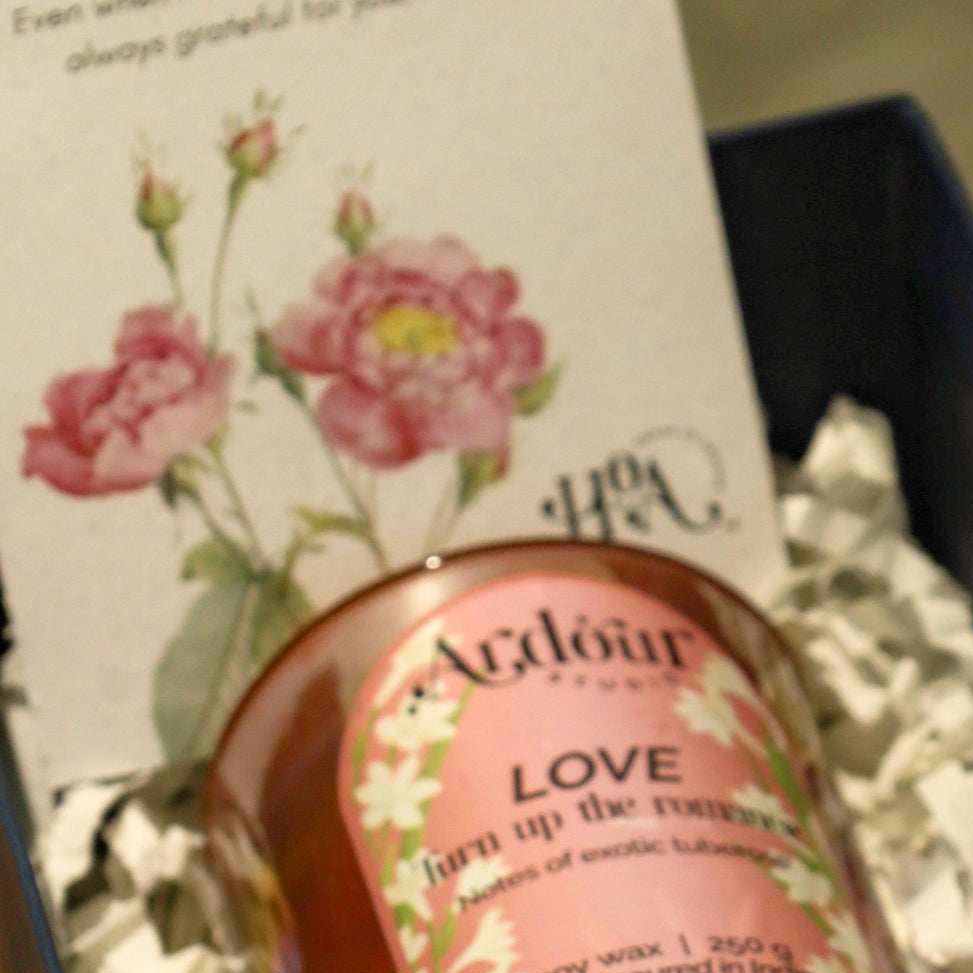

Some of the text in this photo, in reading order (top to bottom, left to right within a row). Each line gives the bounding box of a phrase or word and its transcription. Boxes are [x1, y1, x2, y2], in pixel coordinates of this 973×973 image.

[12, 5, 84, 37] Even
[66, 40, 168, 74] always
[175, 0, 292, 58] grateful
[512, 745, 684, 804] LOVE
[513, 810, 564, 842] up
[578, 792, 636, 822] the
[457, 865, 540, 911] Notes
[546, 850, 572, 874] of
[581, 838, 664, 863] exotic
[597, 939, 662, 969] wax
[706, 935, 764, 957] 250
[770, 942, 793, 964] g
